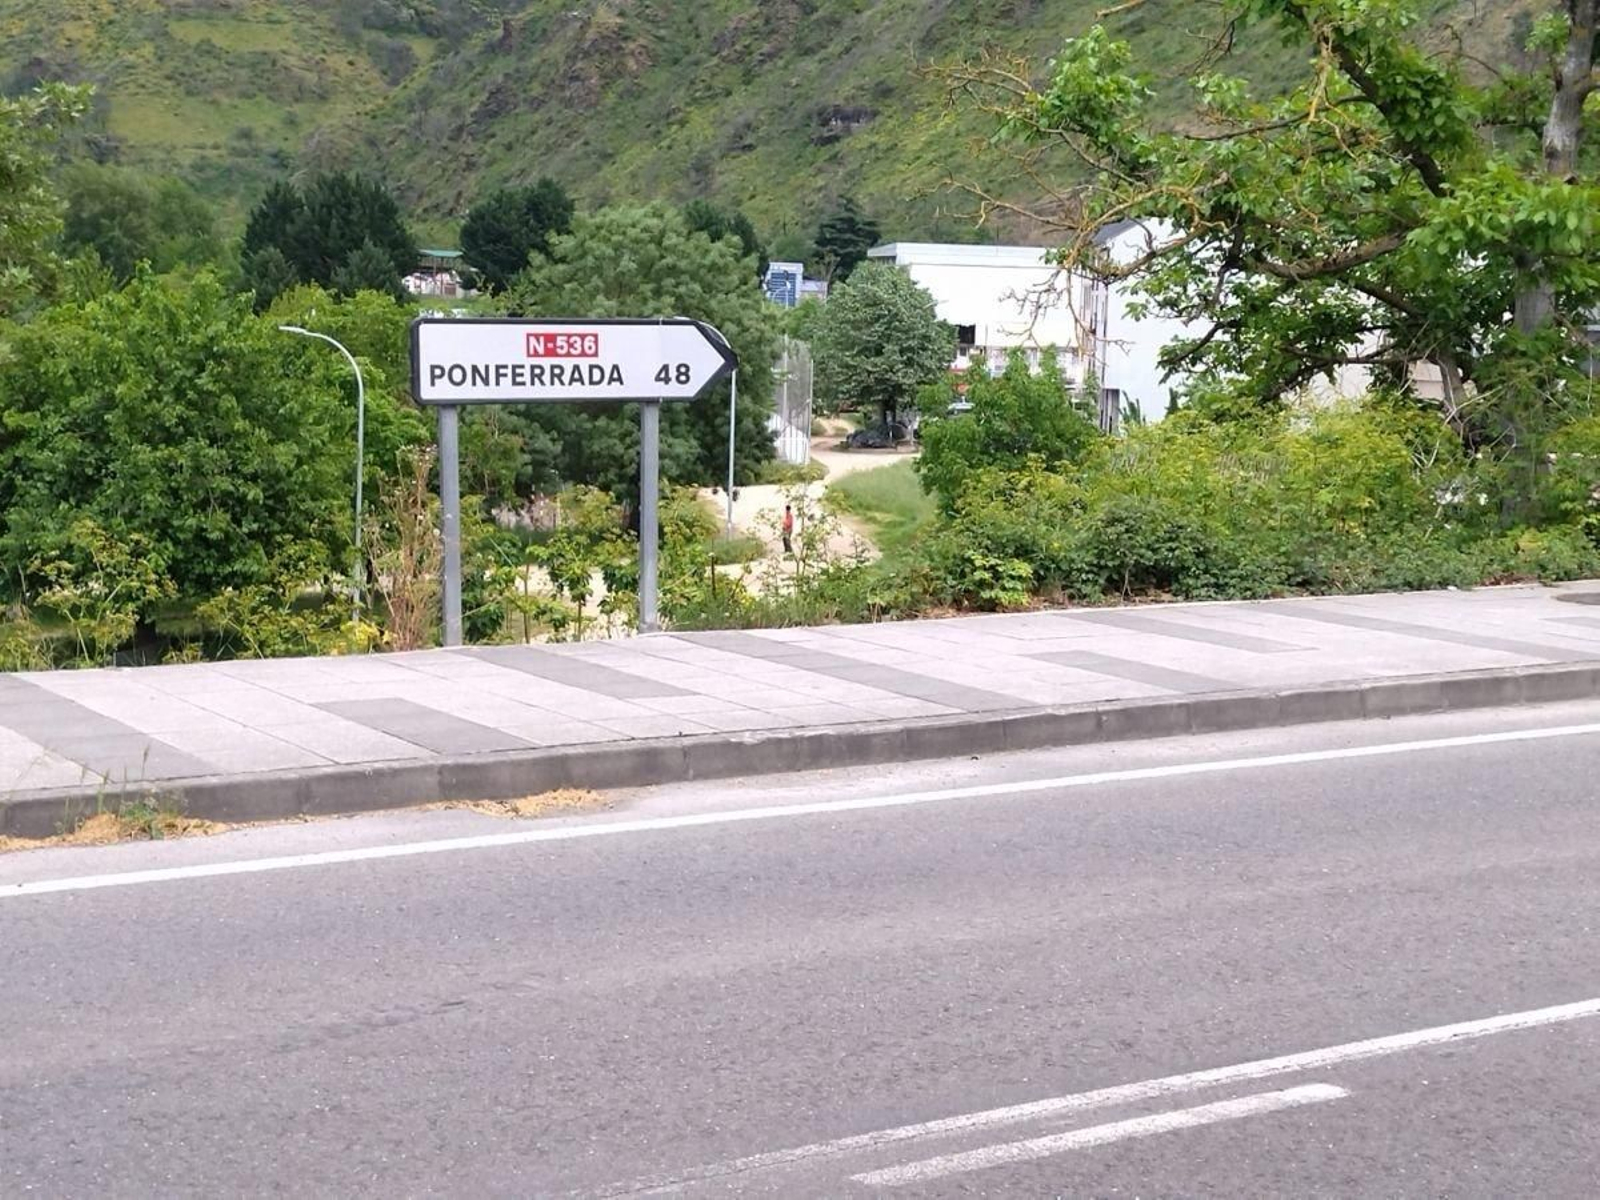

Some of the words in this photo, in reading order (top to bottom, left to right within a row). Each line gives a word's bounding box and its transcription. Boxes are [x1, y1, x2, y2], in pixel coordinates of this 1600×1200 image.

[528, 335, 597, 355] N-536
[429, 363, 625, 387] PONFERRADA
[654, 362, 691, 386] 48
